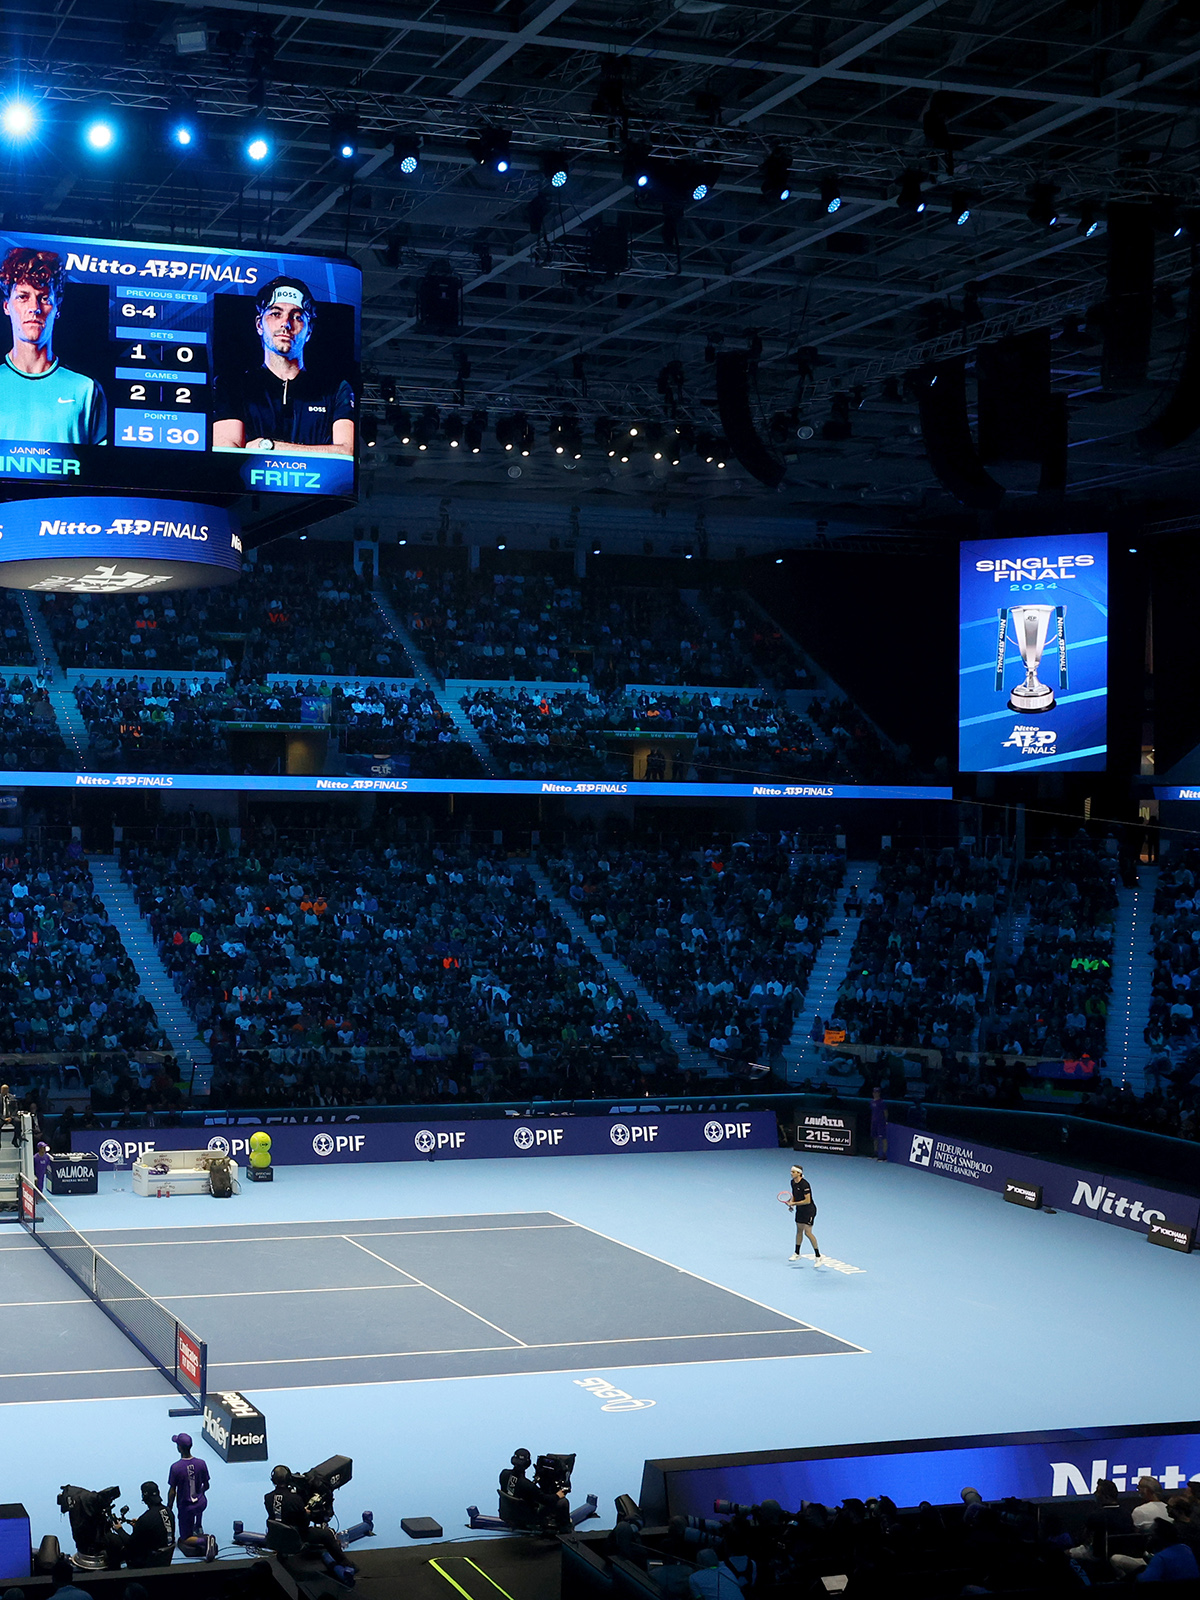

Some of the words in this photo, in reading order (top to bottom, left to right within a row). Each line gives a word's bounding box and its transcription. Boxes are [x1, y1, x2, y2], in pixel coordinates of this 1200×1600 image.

[65, 253, 136, 275] Nitto
[139, 259, 188, 279] ATP
[188, 263, 258, 284] FINALS
[126, 289, 173, 299] PREVIOUS
[175, 293, 198, 301] SETS
[277, 291, 297, 299] BOSS
[121, 303, 156, 319] 6-4
[150, 332, 174, 340] SETS
[130, 344, 146, 360] 1
[176, 346, 193, 363] 0
[144, 371, 178, 380] GAMES
[130, 385, 146, 401] 2
[175, 387, 191, 403] 2
[144, 412, 178, 421] POINTS
[121, 425, 154, 442] 15
[166, 428, 199, 445] 30
[9, 446, 51, 456] JANNIK
[265, 460, 307, 470] TAYLOR
[250, 469, 321, 489] FRITZ
[38, 520, 102, 536] Nitto
[105, 518, 151, 536] ATP
[152, 521, 209, 541] FINALS
[231, 533, 243, 554] Nit
[975, 554, 1095, 572] SINGLES
[994, 567, 1076, 582] FINAL
[1009, 582, 1058, 592] 2024
[1000, 730, 1057, 747] ATP
[1021, 746, 1057, 754] FINALS
[75, 775, 110, 785] Nitto
[112, 776, 136, 786] ATP
[137, 776, 173, 786] FINALS
[316, 779, 349, 789] Nitto
[350, 780, 373, 789] ATP
[374, 780, 408, 790] FINALS
[541, 783, 572, 792] Nitto
[573, 783, 595, 792] ATP
[595, 784, 627, 793] FINALS
[752, 786, 781, 795] Nitto
[783, 787, 803, 795] ATP
[803, 787, 833, 796] FINALS
[1179, 789, 1200, 799] Nitt
[804, 1115, 844, 1127] LAVAZZA
[535, 1128, 563, 1146] PIF
[631, 1125, 658, 1142] PIF
[725, 1122, 751, 1139] PIF
[805, 1130, 830, 1141] 215
[231, 1139, 252, 1155] PI
[335, 1134, 365, 1152] PIF
[437, 1131, 466, 1148] PIF
[124, 1141, 156, 1159] PIF
[936, 1142, 973, 1159] FIDEURAM
[933, 1159, 953, 1173] PRIVATE
[953, 1165, 980, 1179] BANKING
[934, 1151, 958, 1165] INTESA
[959, 1157, 993, 1174] SANPAOLO
[55, 1165, 95, 1178] VALMORA
[1071, 1180, 1166, 1225] Nitto
[1160, 1228, 1188, 1240] YOKOHAMA
[179, 1336, 199, 1367] Emirates
[202, 1405, 229, 1449] Haier
[231, 1432, 264, 1446] Haier
[1050, 1460, 1200, 1497] Nitt
